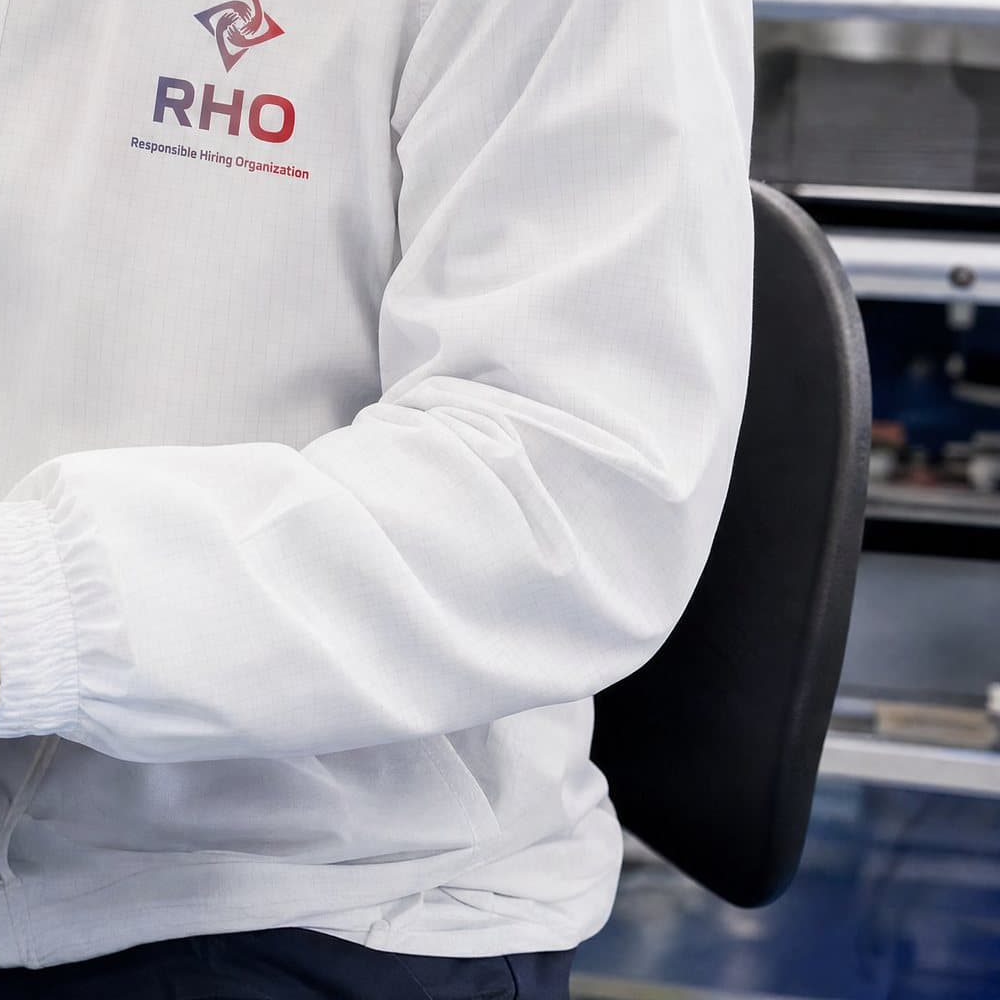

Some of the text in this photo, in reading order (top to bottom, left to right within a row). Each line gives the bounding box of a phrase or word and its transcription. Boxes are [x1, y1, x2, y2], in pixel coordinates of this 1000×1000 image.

[152, 75, 296, 144] RHO
[130, 136, 310, 180] Responsible Hiring Organization
